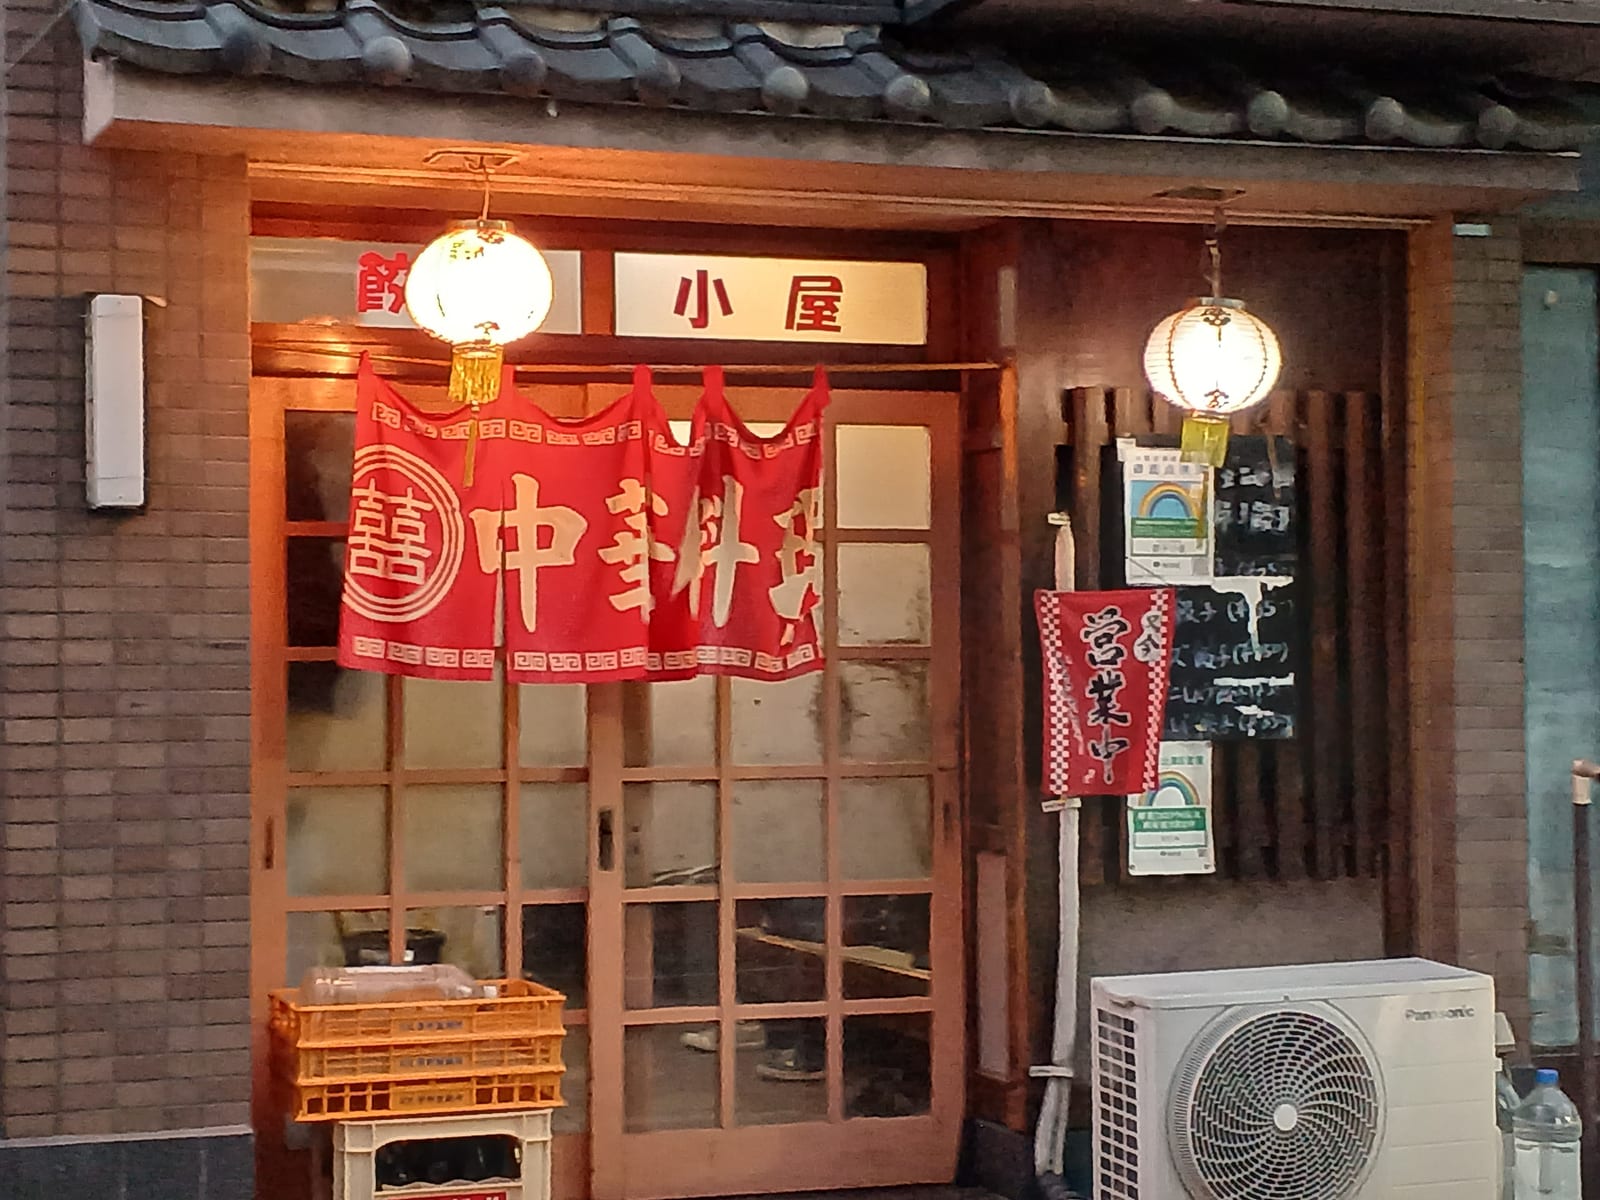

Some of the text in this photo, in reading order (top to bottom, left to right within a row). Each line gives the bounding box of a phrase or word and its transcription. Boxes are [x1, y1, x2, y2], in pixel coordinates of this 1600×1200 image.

[673, 270, 844, 333] 小屋
[1081, 606, 1131, 784] 営業中
